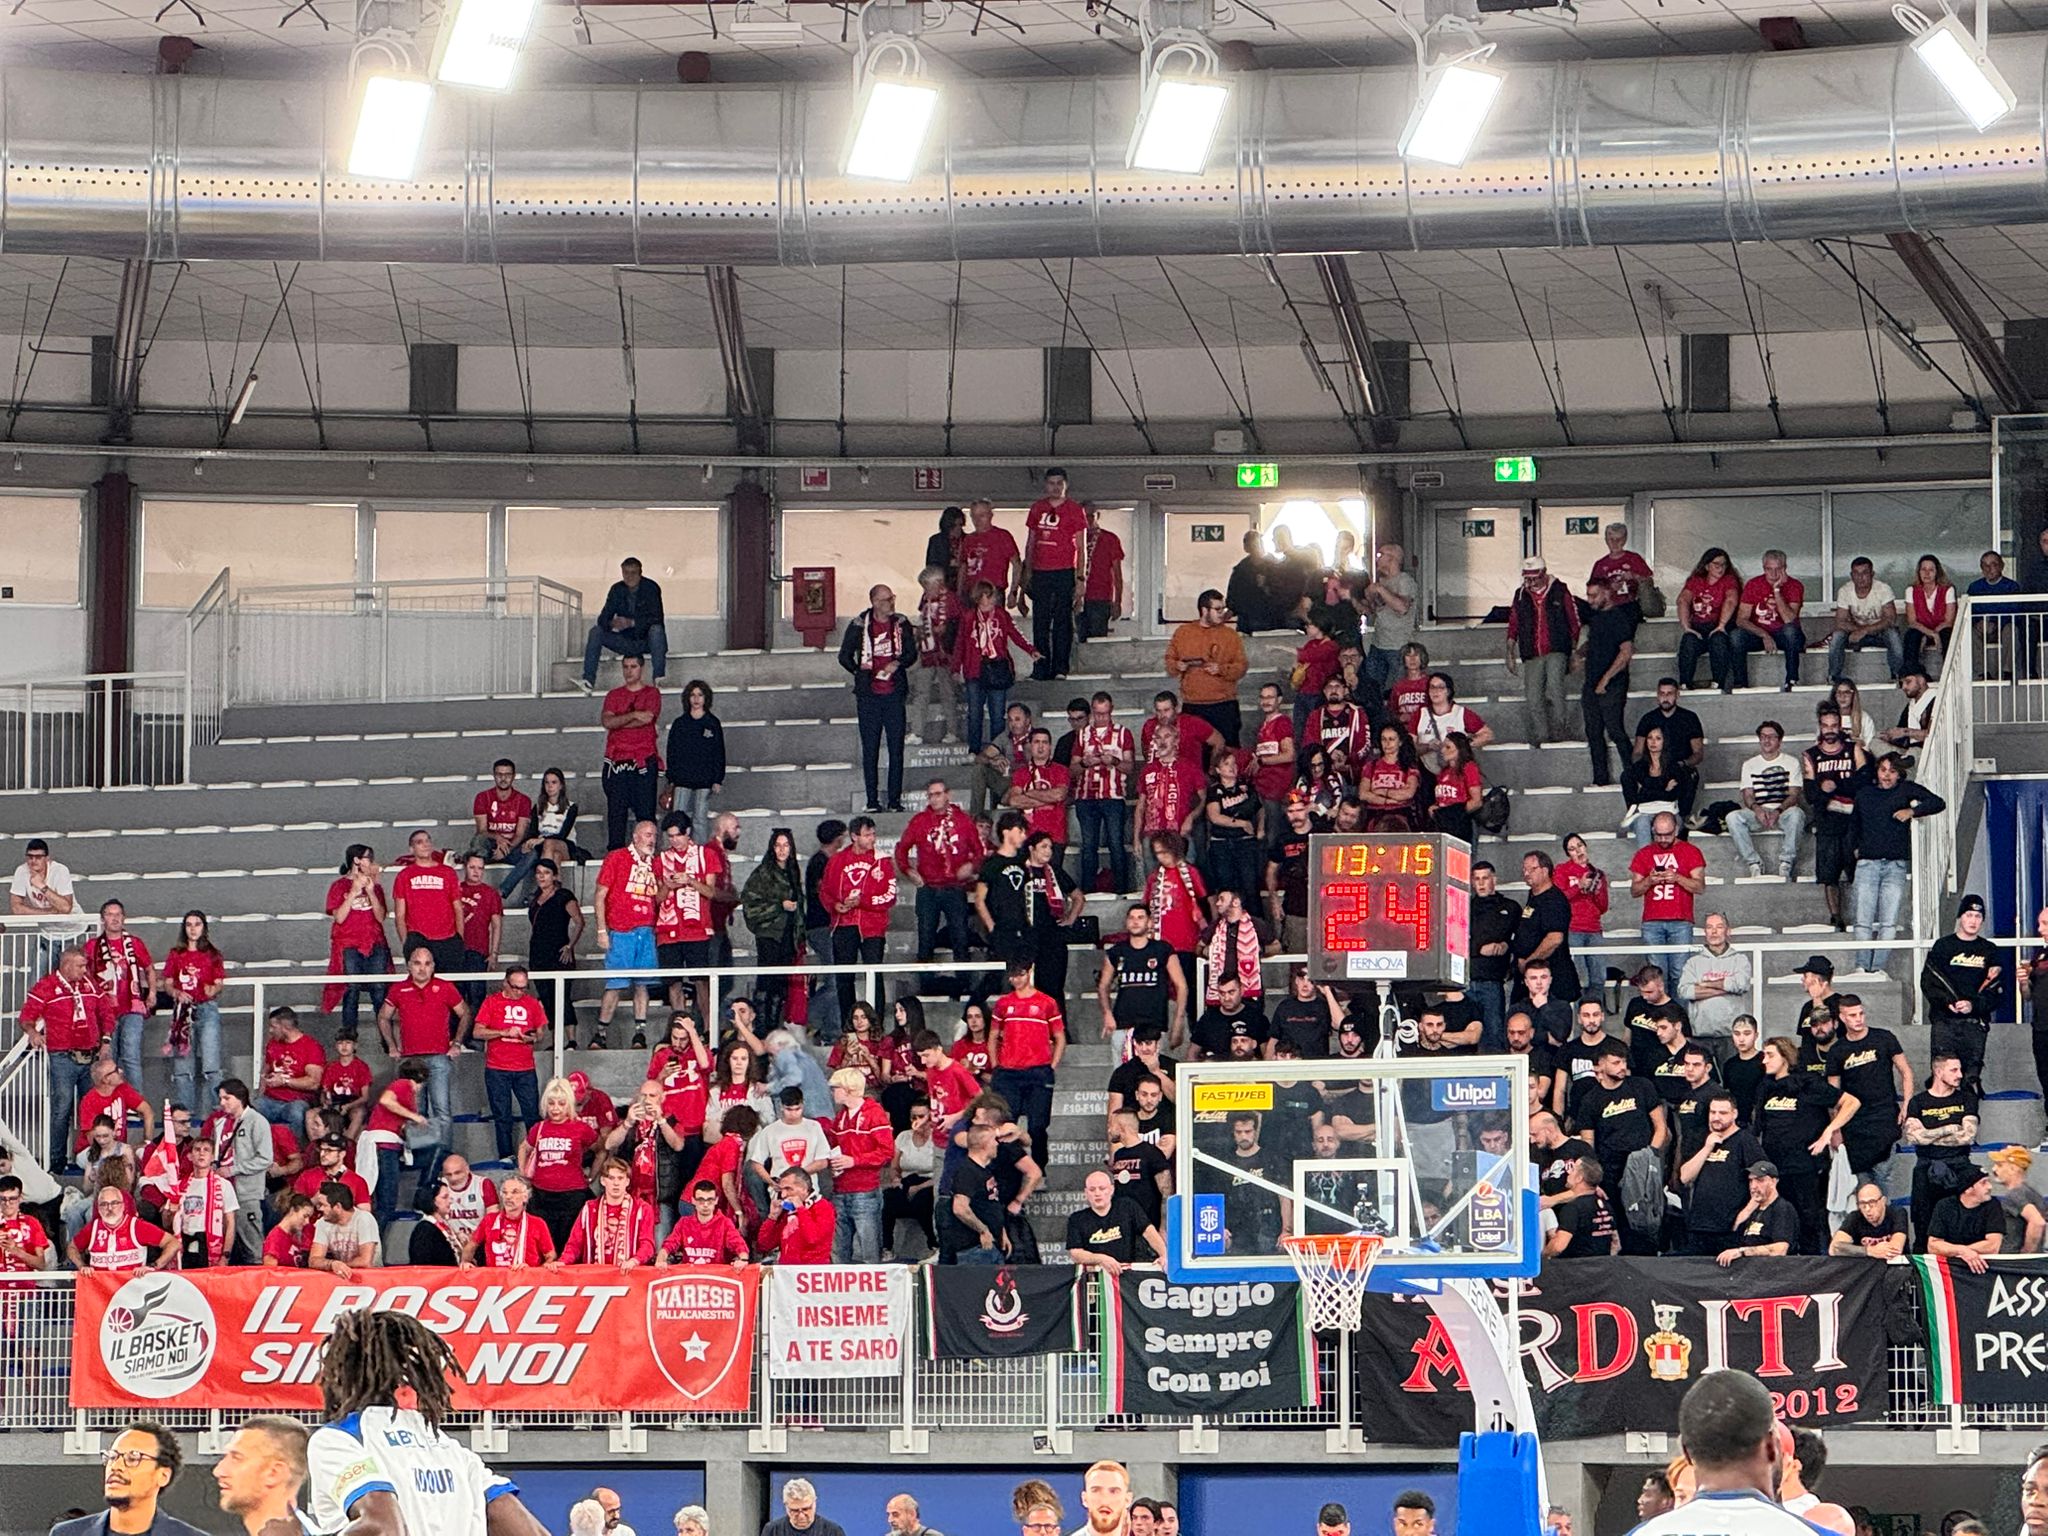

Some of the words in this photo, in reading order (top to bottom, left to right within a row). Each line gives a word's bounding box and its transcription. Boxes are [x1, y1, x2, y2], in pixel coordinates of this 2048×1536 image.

[1335, 844, 1433, 876] 13:15
[1325, 883, 1430, 951] 24
[1350, 957, 1405, 970] FERNOVA
[504, 1005, 528, 1021] 10
[1201, 1090, 1266, 1103] FASTWEB
[1447, 1081, 1496, 1106] Unipol
[1475, 1209, 1503, 1221] LBA
[1197, 1233, 1222, 1243] FIP
[1477, 1231, 1501, 1244] Unipol
[655, 1284, 736, 1308] VARESE
[796, 1271, 888, 1294] SEMPRE
[1987, 1274, 2048, 1318] ASS
[241, 1286, 303, 1333] IL
[1138, 1278, 1275, 1317] Gaggio
[656, 1309, 735, 1320] PALLACANESTRO
[797, 1305, 889, 1328] INSIEME
[111, 1339, 126, 1361] IL
[129, 1321, 203, 1358] BASKET
[786, 1341, 802, 1362] A
[806, 1340, 833, 1361] TE
[840, 1333, 898, 1361] SARÒ
[1145, 1326, 1273, 1359] Sempre
[1975, 1331, 2048, 1378] PRE
[124, 1353, 164, 1374] SIAMO
[168, 1347, 188, 1366] NOI
[466, 1342, 588, 1385] NOI
[1148, 1366, 1211, 1393] Con
[1219, 1360, 1272, 1392] noi
